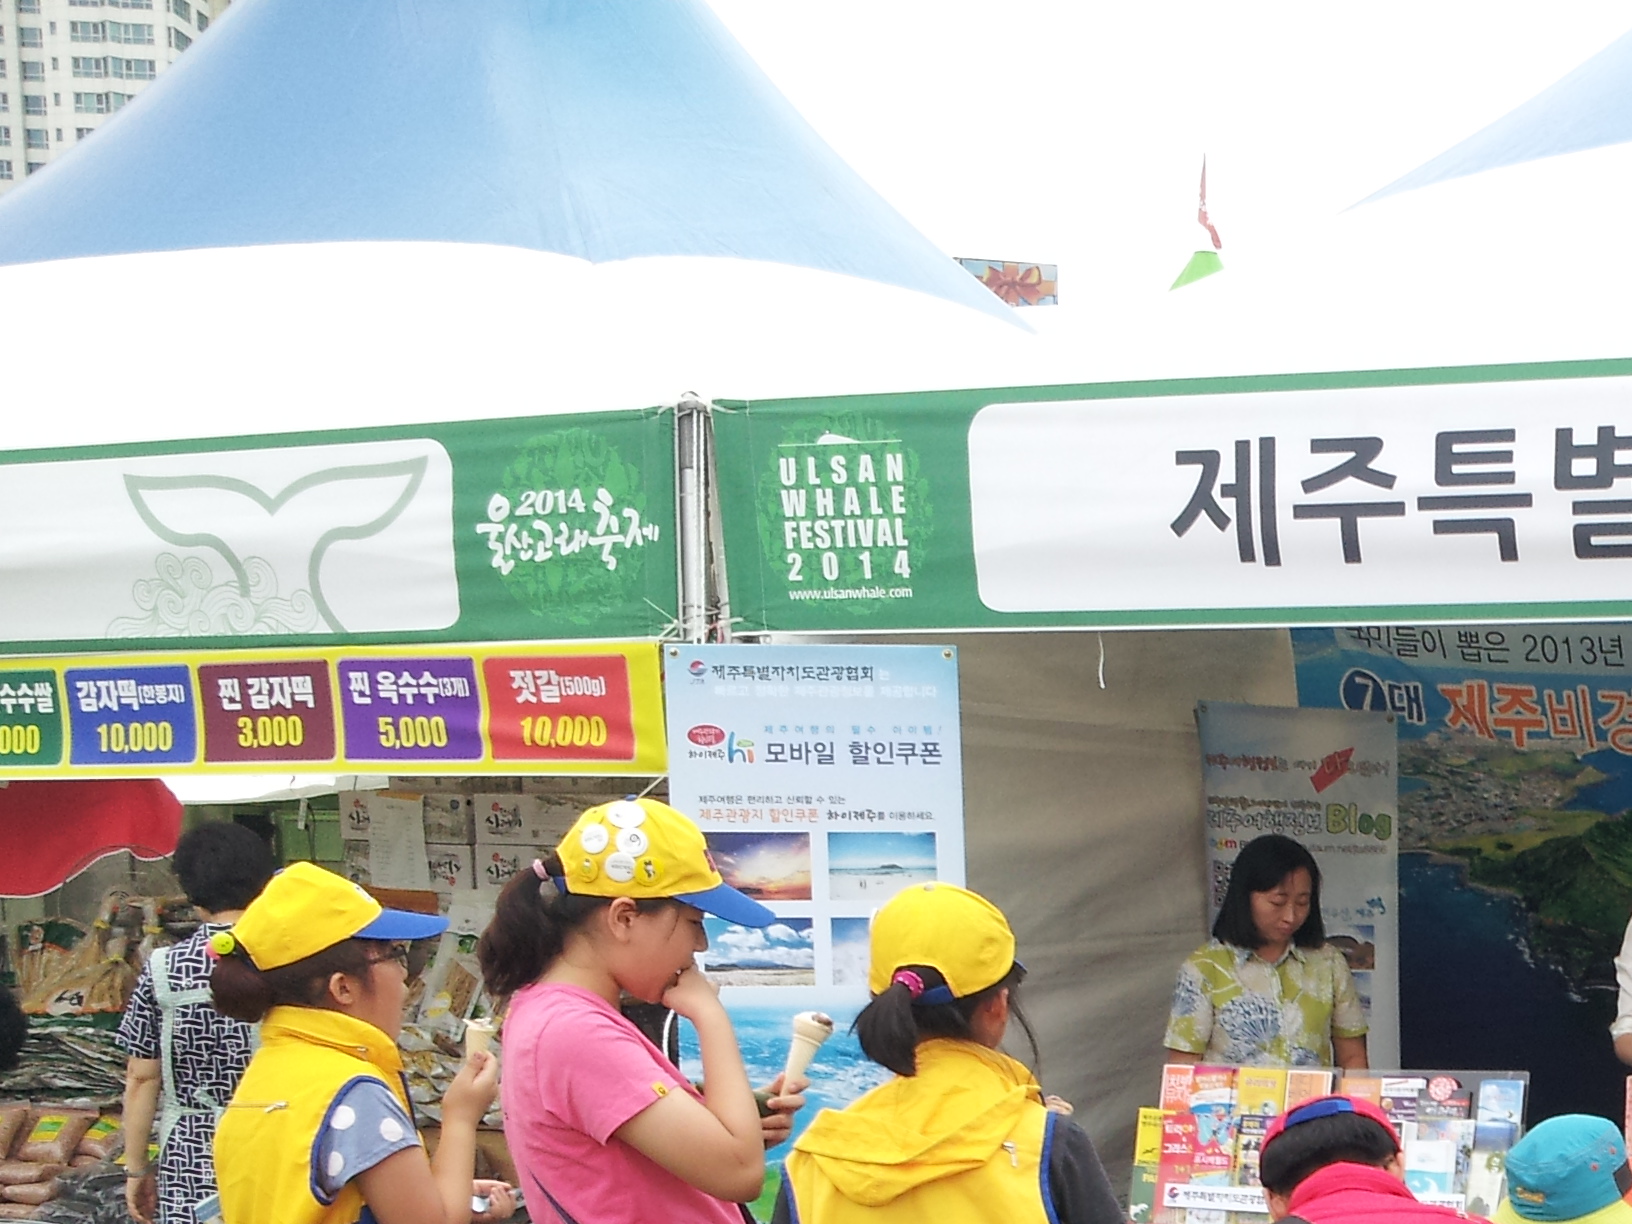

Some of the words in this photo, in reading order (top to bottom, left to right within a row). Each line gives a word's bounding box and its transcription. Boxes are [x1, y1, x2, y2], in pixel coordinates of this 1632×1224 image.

[779, 451, 905, 487] ULSAN
[514, 490, 586, 518] 2014
[781, 484, 907, 520] WHALE
[475, 487, 660, 575] 울산고래축제
[784, 517, 909, 550] FESTIVAL
[787, 549, 911, 583] 2014
[788, 584, 913, 602] www.ulsanwhale.com
[1456, 629, 1510, 664] 뽑은
[1521, 633, 1625, 669] 2013년
[217, 678, 243, 711] 찐
[247, 675, 316, 709] 감자떡
[348, 671, 373, 705] 찐
[508, 668, 607, 704] 젓갈(500g)
[97, 721, 173, 754] 10,000
[237, 715, 304, 749] 3,000
[378, 716, 448, 749] 5,000
[519, 714, 608, 749] 10,000
[765, 741, 836, 766] 모바일
[849, 741, 943, 766] 할인쿠폰
[1325, 802, 1393, 841] Blog
